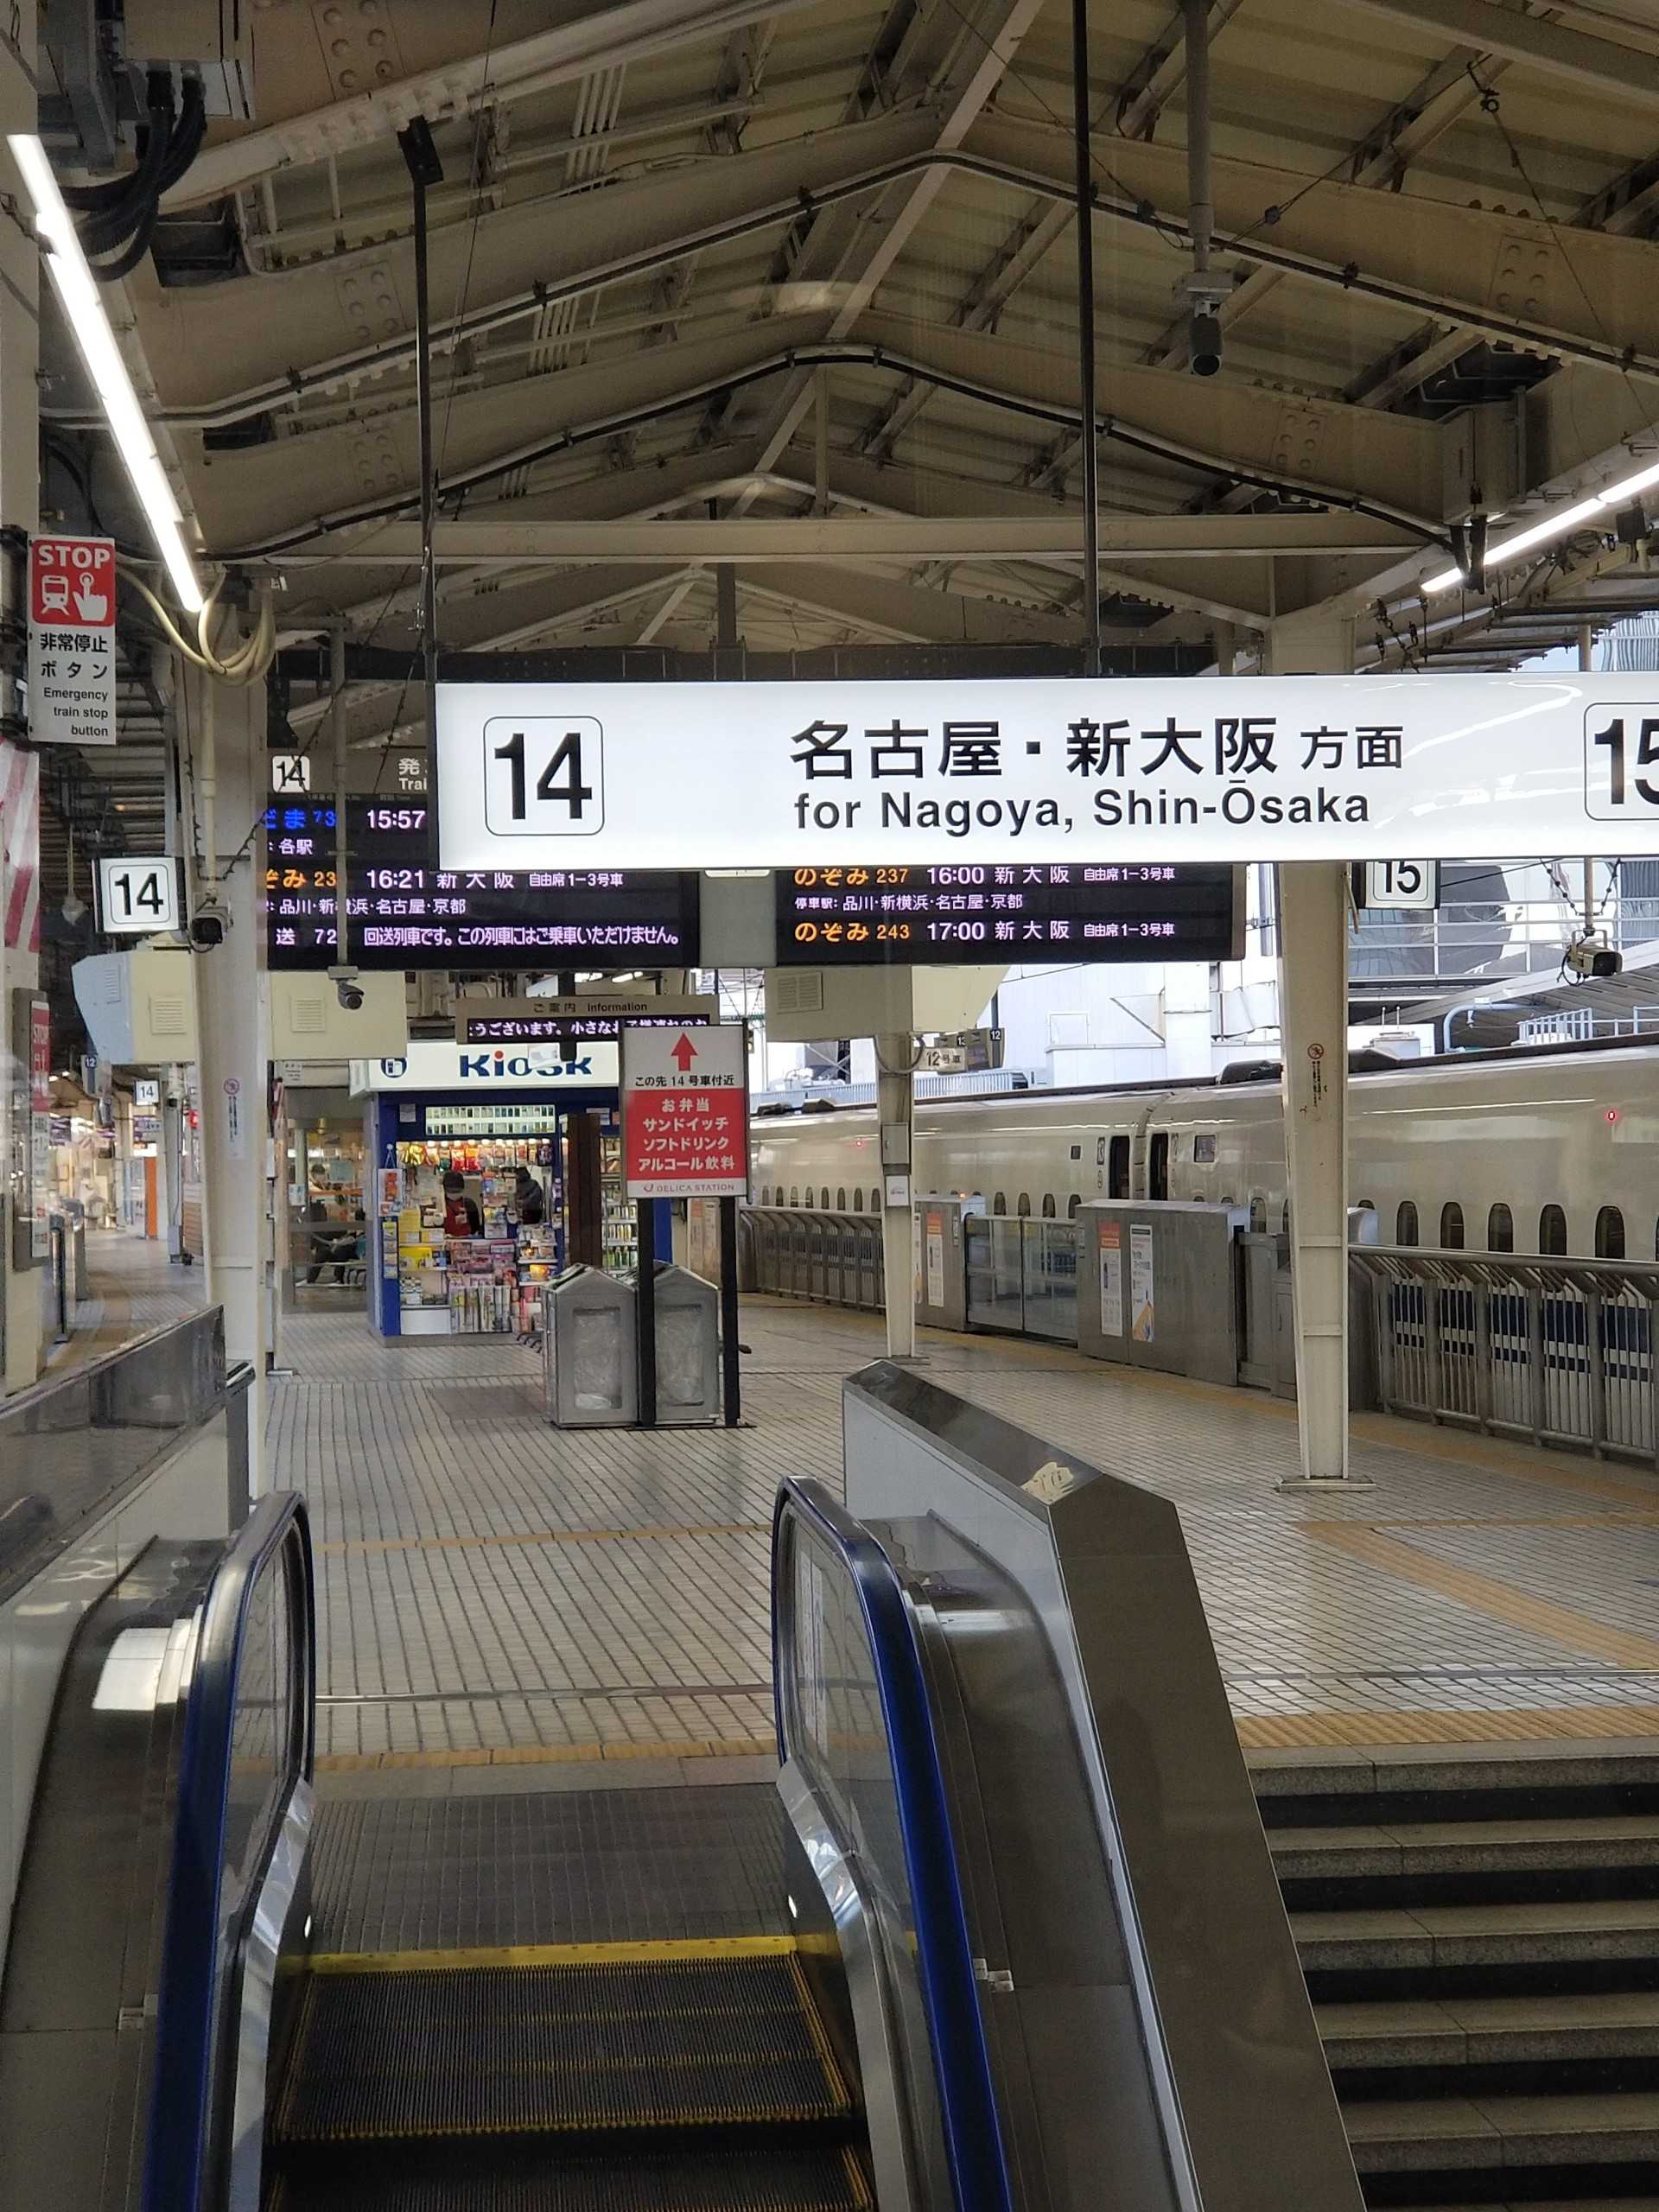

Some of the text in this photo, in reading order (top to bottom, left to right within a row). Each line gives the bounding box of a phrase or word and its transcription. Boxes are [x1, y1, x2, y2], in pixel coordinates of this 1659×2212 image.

[38, 544, 111, 569] STOP
[40, 632, 108, 653] 非常停止
[41, 660, 108, 679] ボタン
[43, 687, 108, 702] Emergency
[54, 705, 108, 720] train stop
[71, 724, 108, 736] button
[1594, 718, 1659, 804] 15
[276, 760, 306, 787] 14
[495, 733, 593, 820] 14
[794, 779, 1370, 837] for Nagoya, Shin-Ōsaka
[366, 809, 426, 830] 15:57
[366, 869, 425, 889] 16:21
[436, 873, 514, 889] 新大阪
[794, 868, 869, 887] のぞみ
[876, 868, 909, 884] 237
[927, 867, 984, 886] 16:00
[994, 866, 1071, 885] 新大阪
[1377, 861, 1421, 894] 15
[114, 873, 164, 916] 14
[794, 922, 869, 943] のぞみ
[876, 925, 910, 940] 243
[927, 921, 985, 941] 17:00
[994, 920, 1071, 940] 新大阪
[533, 1002, 576, 1014] ご案内
[990, 1030, 1001, 1040] 12
[140, 1085, 154, 1098] 14
[661, 1097, 709, 1113] お弁当
[643, 1116, 729, 1132] サンドイッチ
[643, 1136, 729, 1151] ソフトドリンク
[639, 1154, 735, 1172] アルコール飲料
[657, 1182, 734, 1193] DELICA STATION
